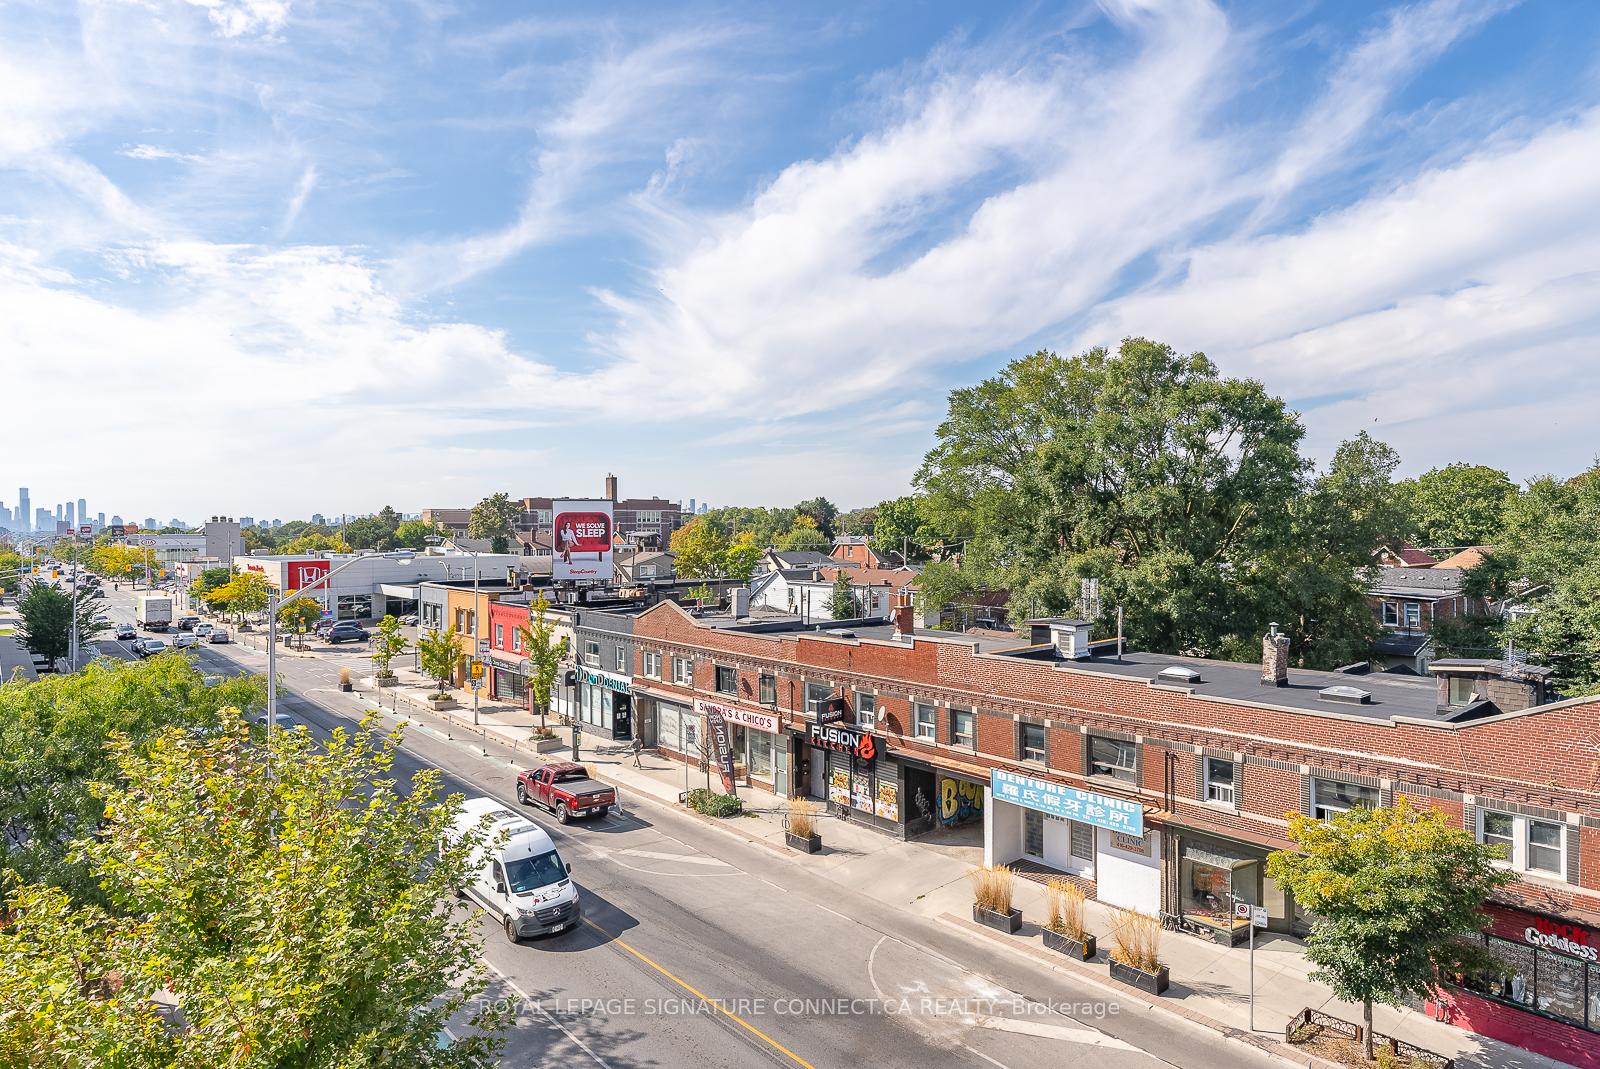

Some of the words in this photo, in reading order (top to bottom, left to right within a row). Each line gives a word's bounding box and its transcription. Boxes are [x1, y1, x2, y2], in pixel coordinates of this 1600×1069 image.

[575, 528, 606, 538] SLEEP
[734, 711, 741, 721] &
[742, 713, 772, 728] CHICO'S
[821, 709, 843, 719] FUSION
[811, 725, 859, 748] FUSION
[996, 771, 1066, 796] DENTURE
[1075, 791, 1136, 813] CLINIC
[1116, 835, 1143, 847] CLINIC
[1524, 926, 1598, 961] Goddess
